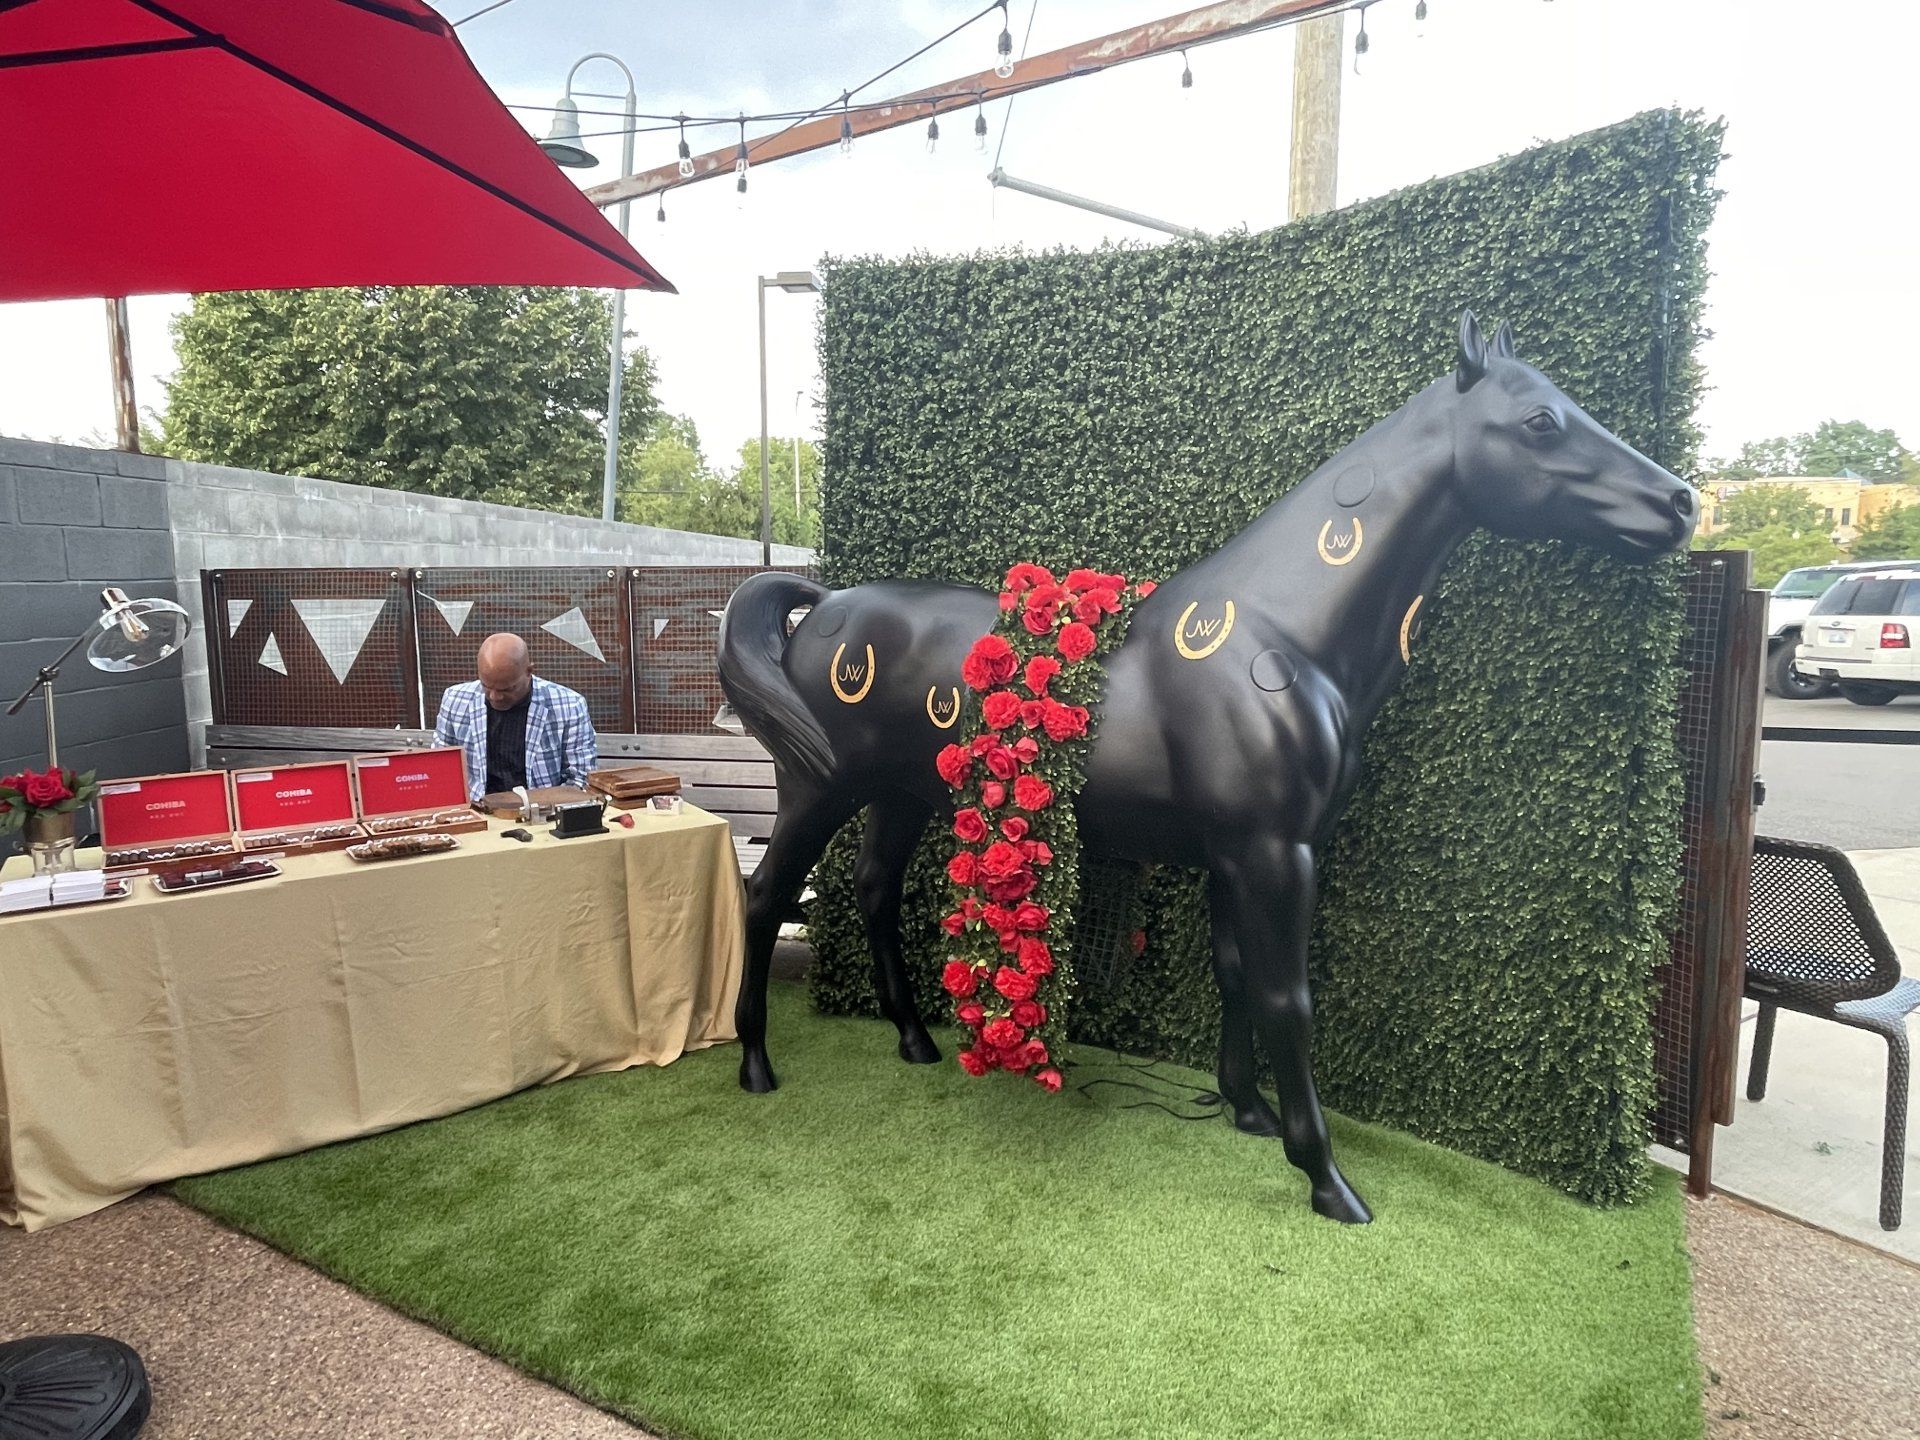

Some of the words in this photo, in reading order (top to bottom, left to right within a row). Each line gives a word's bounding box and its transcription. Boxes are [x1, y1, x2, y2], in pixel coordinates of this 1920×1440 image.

[395, 773, 430, 783] COHIBA
[275, 788, 313, 799] COHIBA
[145, 800, 186, 811] COHIBA
